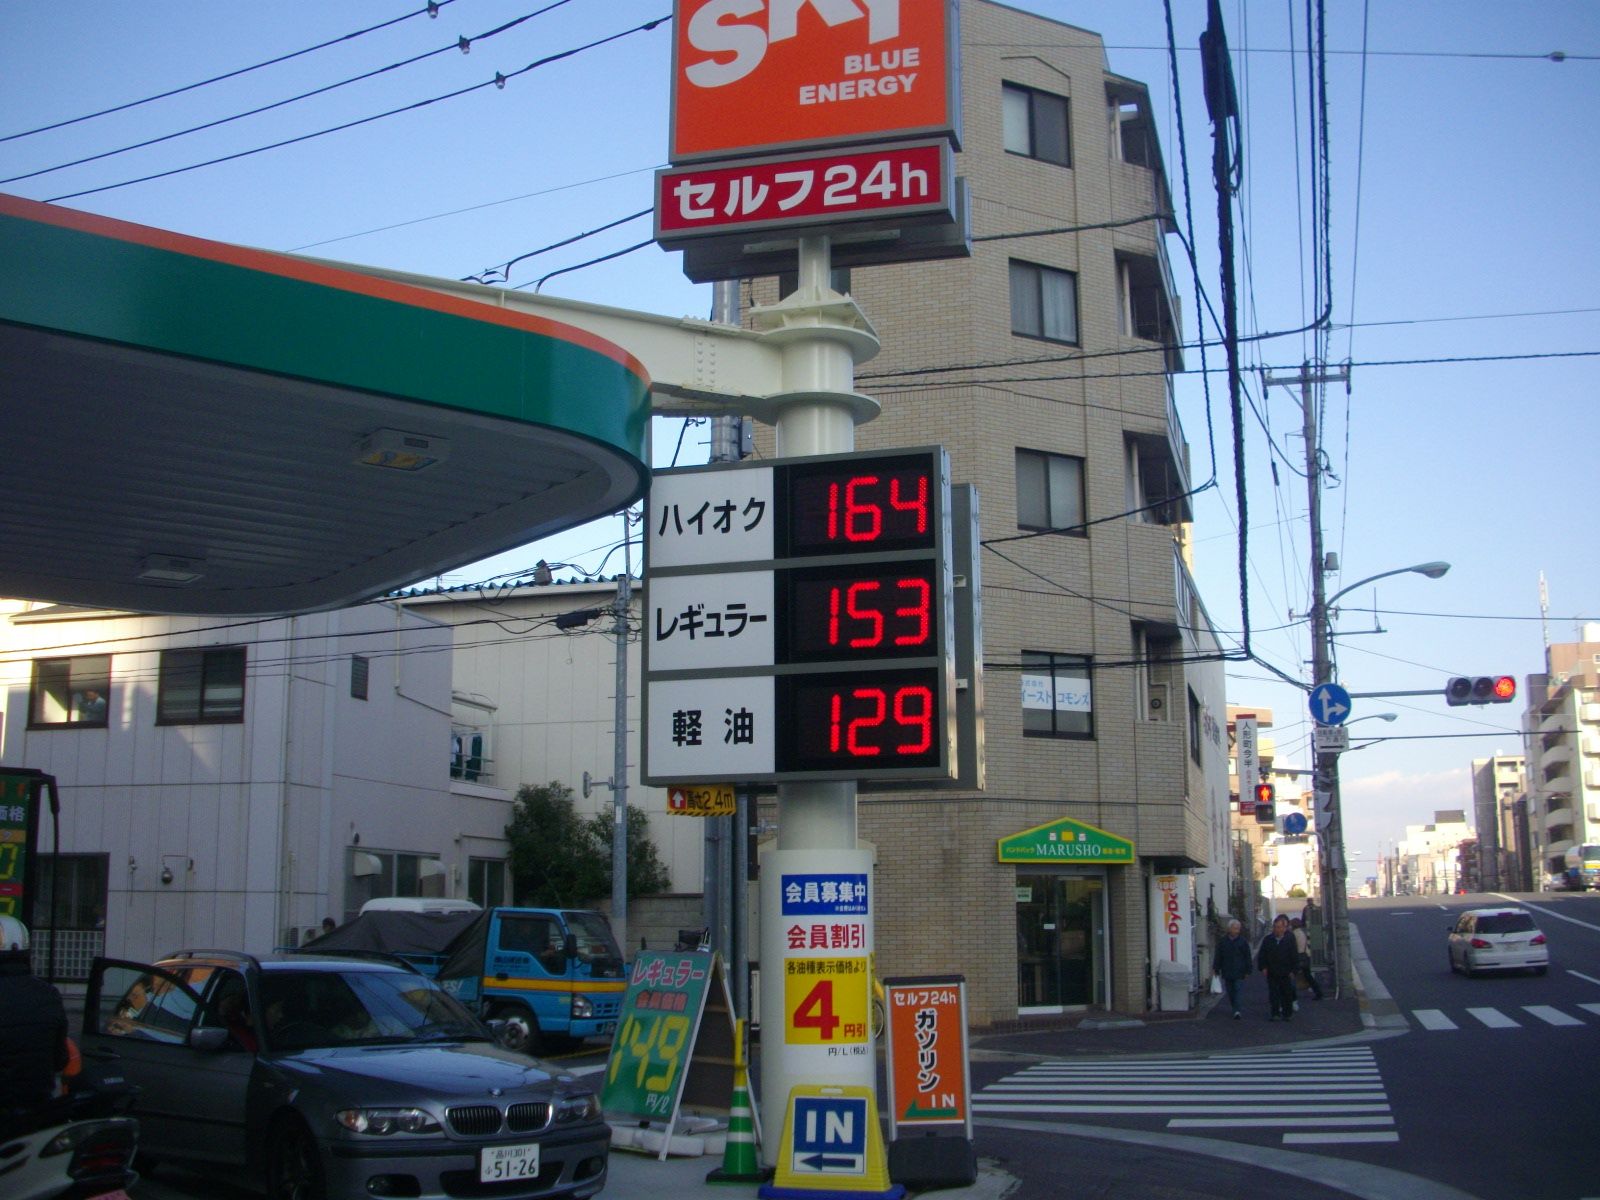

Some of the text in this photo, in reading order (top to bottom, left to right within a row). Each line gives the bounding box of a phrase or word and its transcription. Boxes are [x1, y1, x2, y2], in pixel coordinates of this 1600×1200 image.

[844, 47, 920, 75] BLUE
[799, 73, 917, 105] ENERGY
[673, 160, 929, 220] セルフ24h
[658, 476, 929, 542] ハイオク 164
[656, 577, 931, 648] レギュラー 153
[830, 685, 933, 756] 129
[1036, 843, 1101, 857] MARUSHO
[785, 881, 867, 904] 会員募集中
[787, 924, 865, 950] 会員割引
[632, 958, 705, 988] レギュラー
[792, 980, 840, 1041] 4
[893, 988, 957, 1007] セルフ24h
[609, 1013, 690, 1093] 149
[914, 1007, 940, 1094] ガソリン
[930, 1093, 956, 1109] IN
[805, 1109, 854, 1144] IN
[494, 1158, 536, 1178] 51-26
